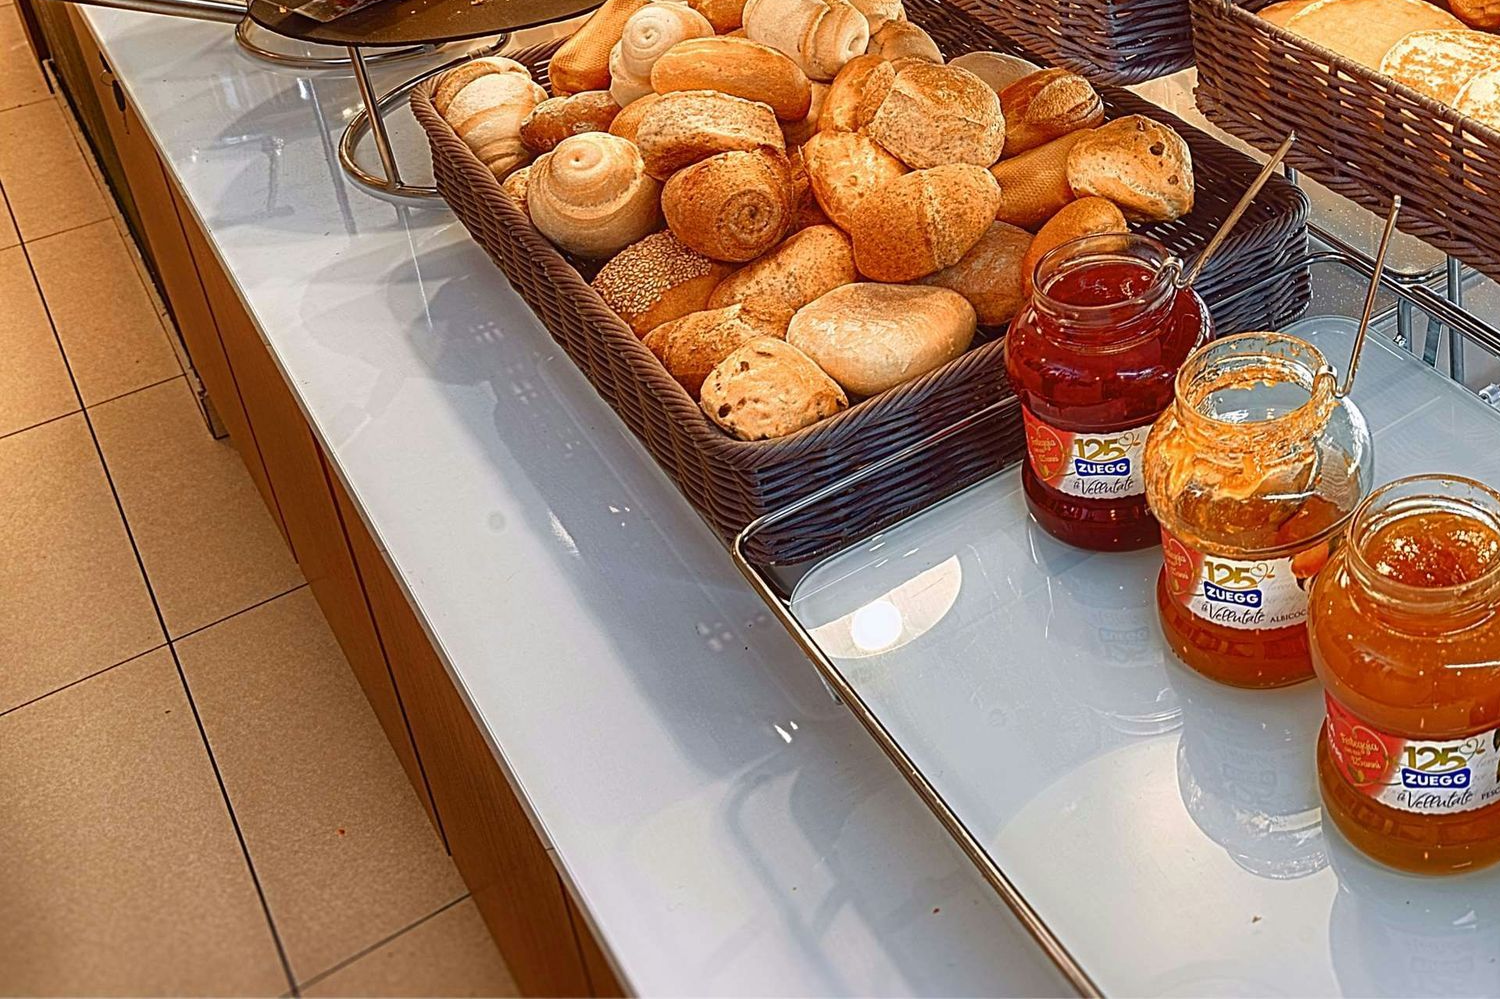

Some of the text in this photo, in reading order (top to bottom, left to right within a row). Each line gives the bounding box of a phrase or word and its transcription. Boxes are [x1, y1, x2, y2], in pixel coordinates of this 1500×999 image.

[1073, 438, 1127, 461] 125
[1077, 462, 1128, 474] ZUEGG
[1080, 475, 1134, 495] Vellutate
[1204, 560, 1259, 588] 125
[1205, 585, 1259, 604] ZUEGG
[1208, 602, 1266, 624] Vellutate
[1269, 608, 1308, 623] ALBICOC
[1404, 746, 1468, 772] 125
[1404, 771, 1467, 785] ZUEGG
[1406, 786, 1475, 809] Vellutate
